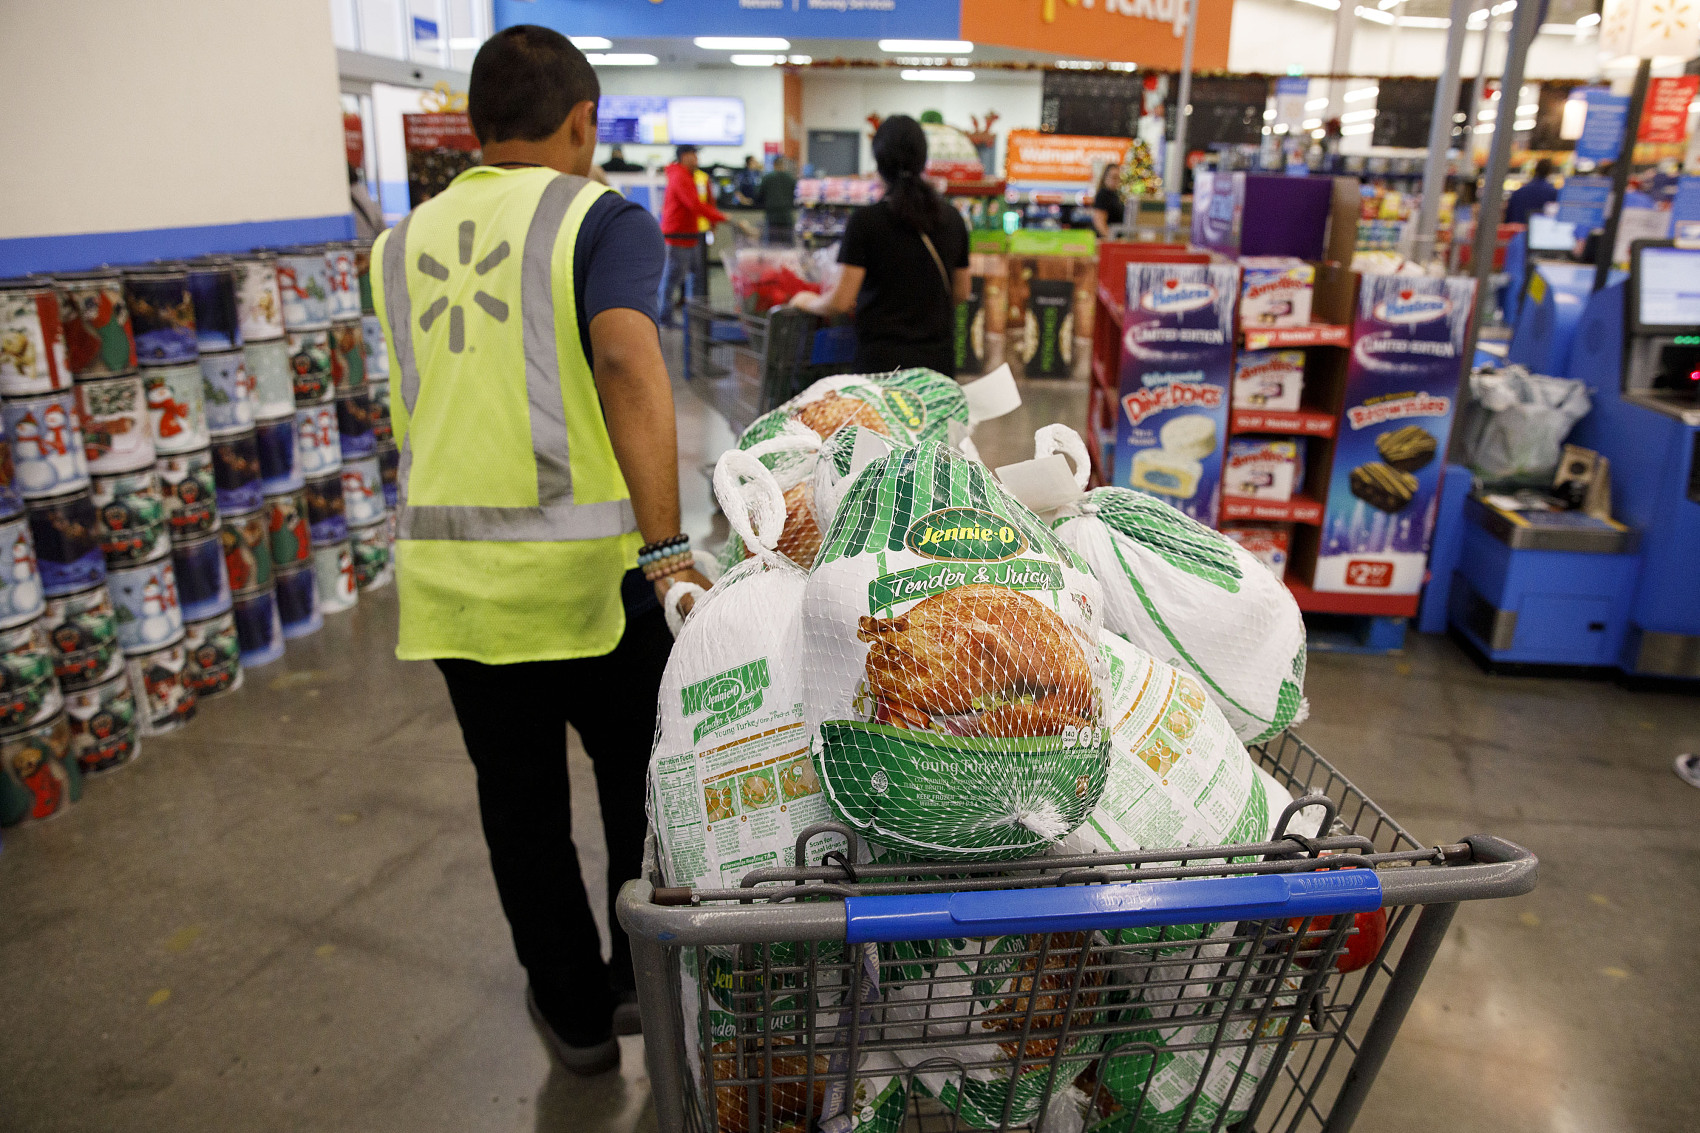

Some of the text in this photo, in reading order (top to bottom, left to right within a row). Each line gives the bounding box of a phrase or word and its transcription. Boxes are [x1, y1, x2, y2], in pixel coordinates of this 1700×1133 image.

[887, 564, 1051, 598] Tender & Juicy
[714, 726, 736, 739] Young
[911, 755, 958, 776] Young
[809, 838, 823, 848] Scan
[823, 835, 833, 844] for
